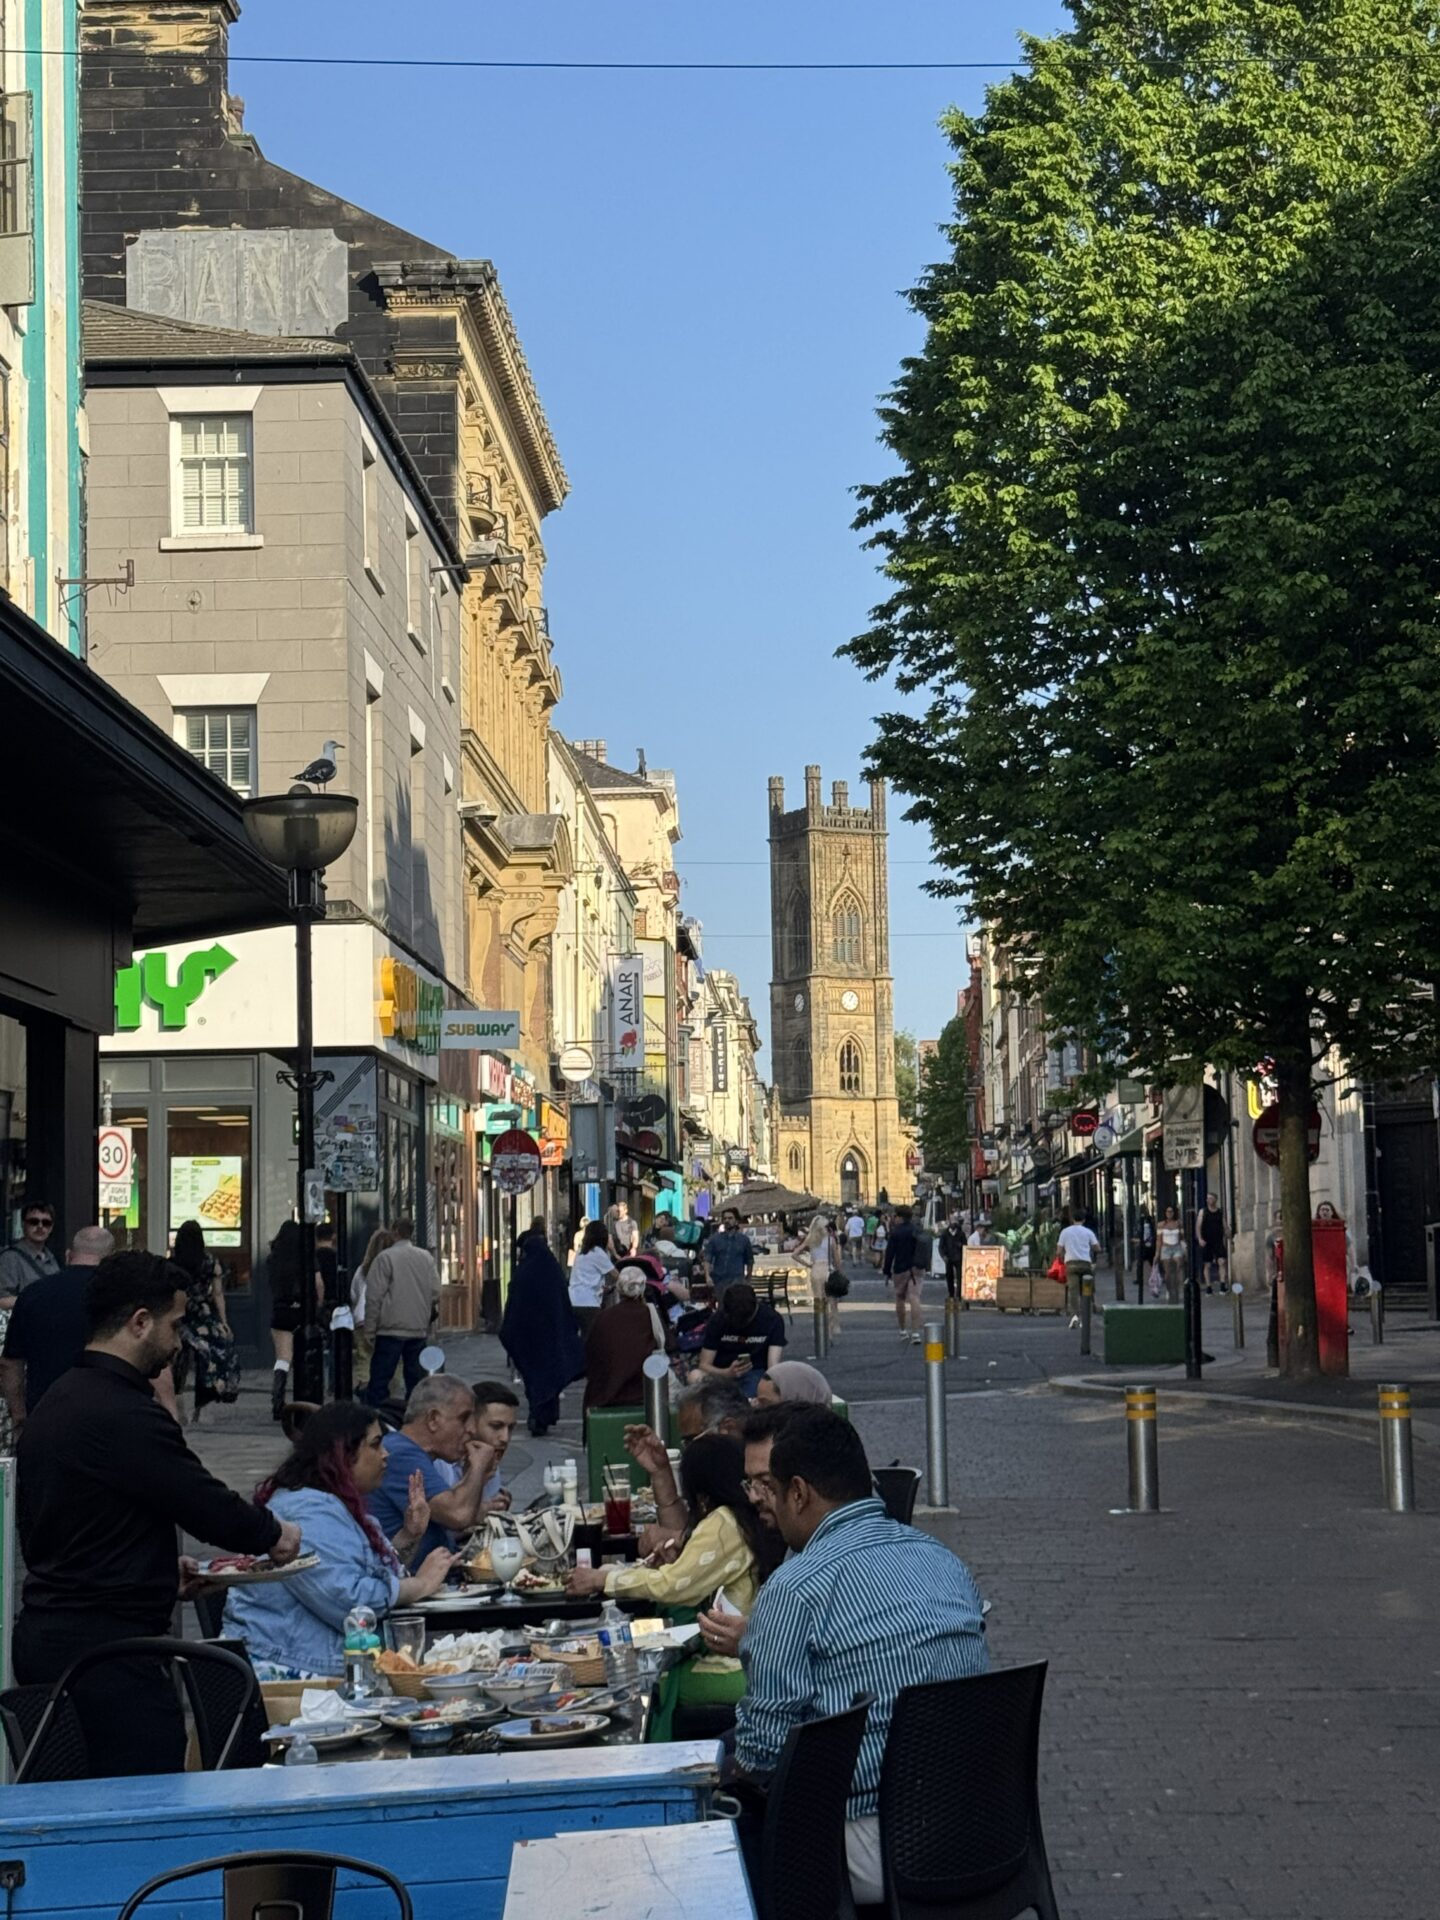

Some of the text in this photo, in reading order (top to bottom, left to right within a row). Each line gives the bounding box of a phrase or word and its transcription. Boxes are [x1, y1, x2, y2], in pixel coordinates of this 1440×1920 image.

[137, 242, 336, 320] BANK
[619, 972, 634, 1025] ANAR
[445, 1023, 515, 1037] SUBWAY
[102, 1146, 123, 1163] 30
[721, 1334, 739, 1342] JACK
